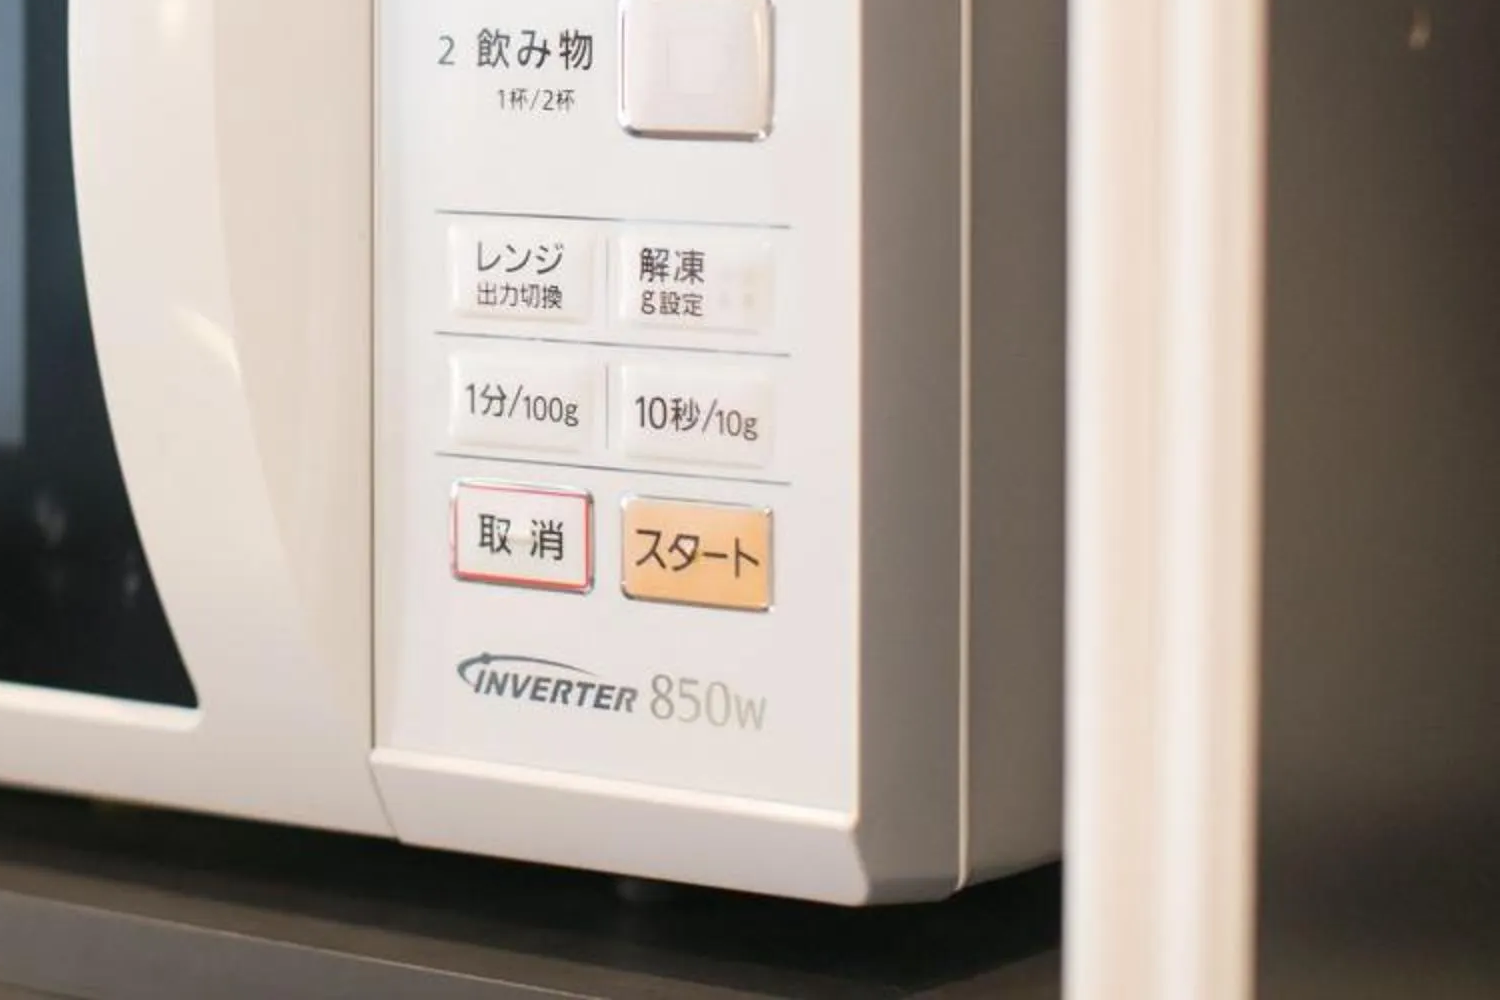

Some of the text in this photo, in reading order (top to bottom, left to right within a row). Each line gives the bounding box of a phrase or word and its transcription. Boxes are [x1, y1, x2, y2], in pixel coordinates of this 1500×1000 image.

[437, 28, 594, 71] 2 飲み物
[497, 88, 575, 112] 1杯/2杯
[477, 241, 564, 275] レンジ
[639, 247, 706, 285] 解凍
[476, 283, 563, 310] 出力切換
[640, 291, 705, 318] g設定
[465, 383, 580, 428] 1分/100g
[635, 396, 759, 442] 10秒/10g
[635, 529, 760, 579] スタート
[474, 669, 639, 714] INVERTER
